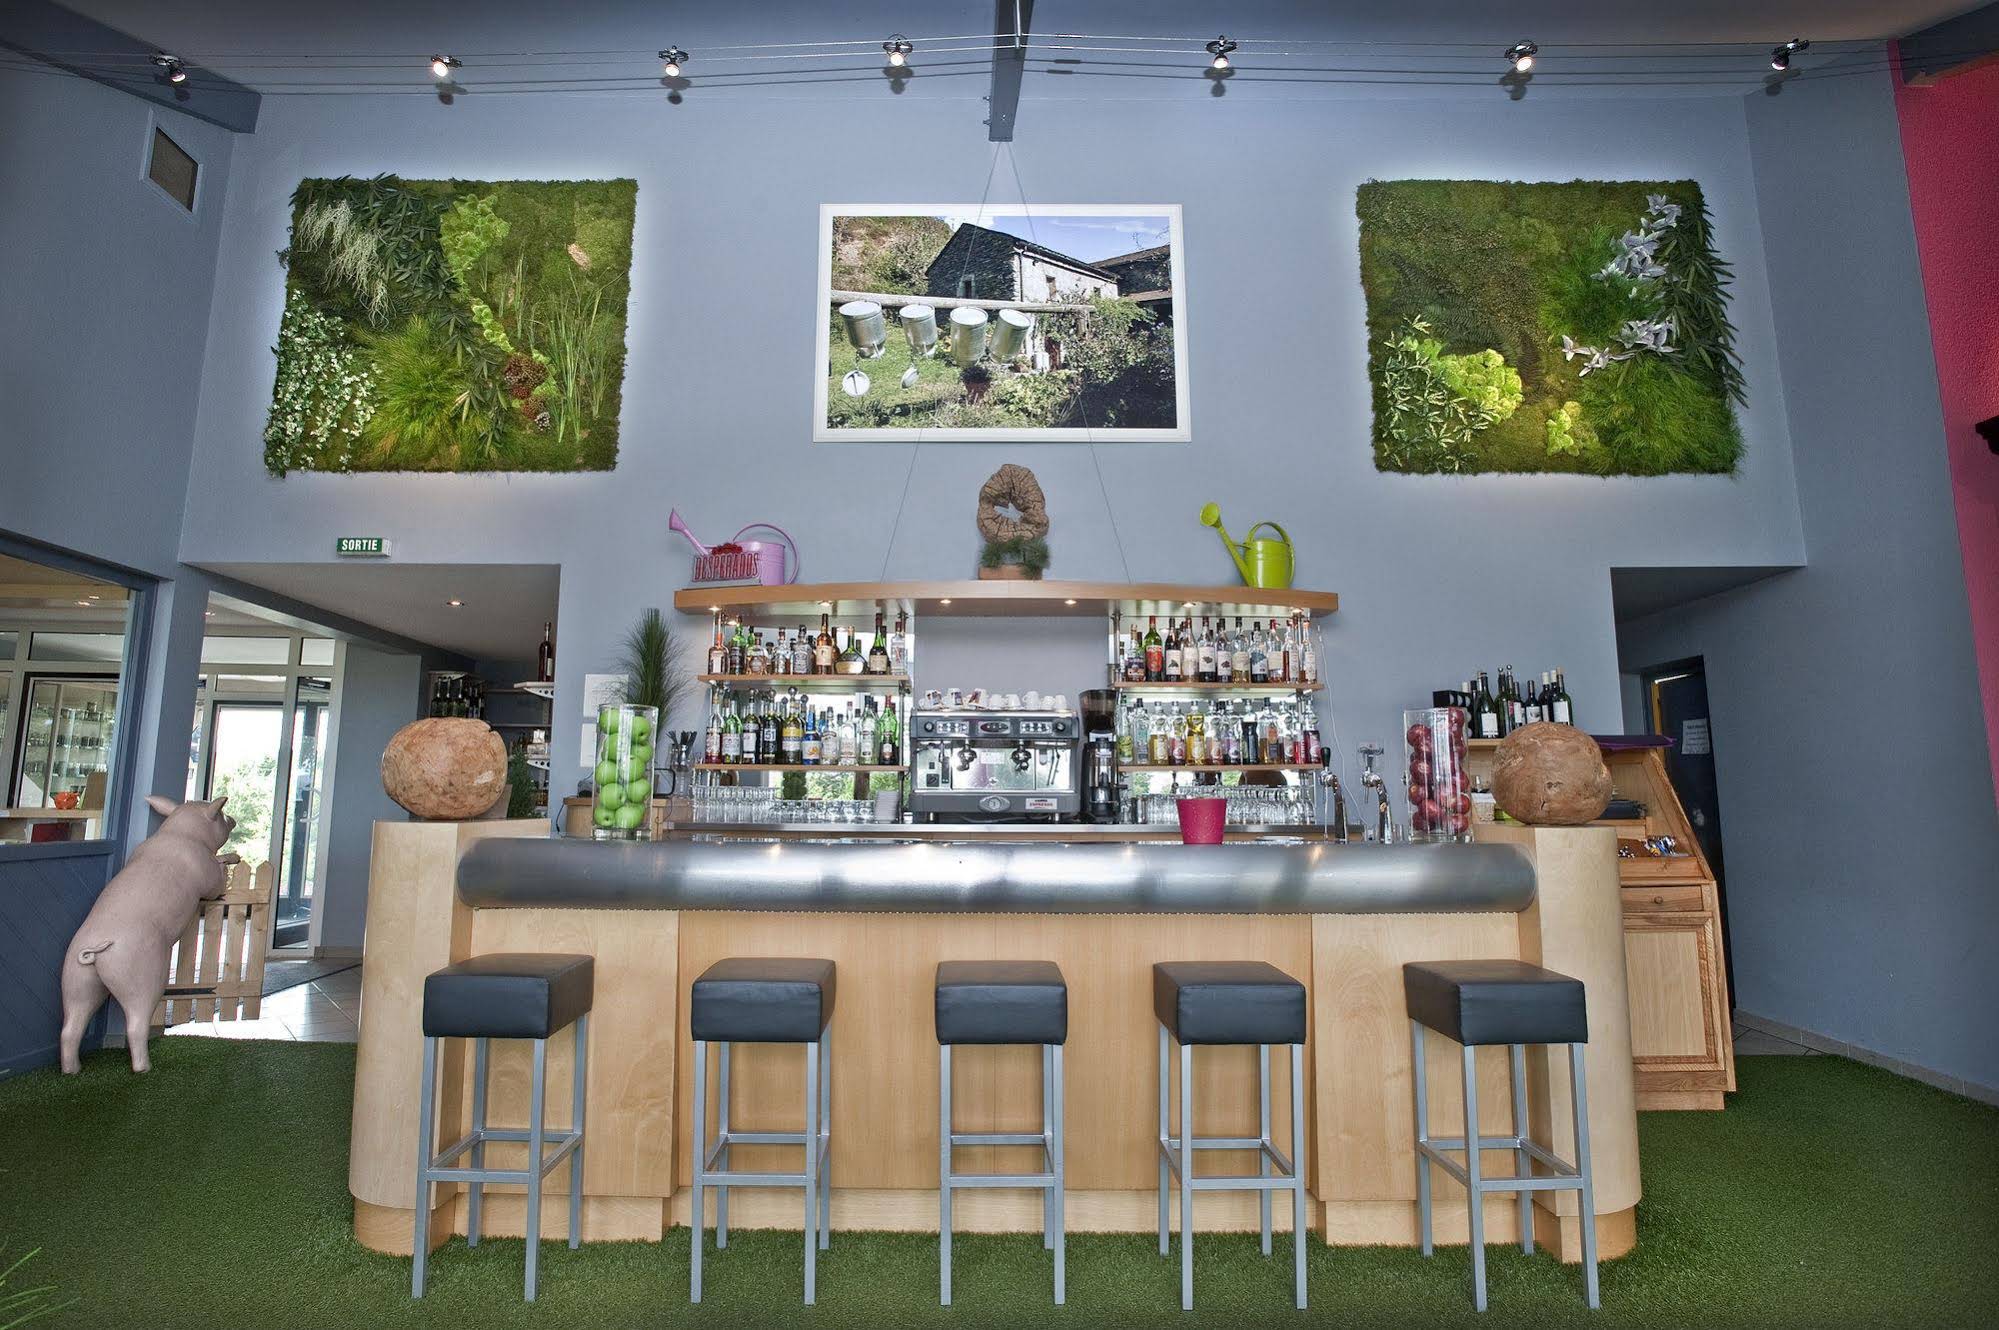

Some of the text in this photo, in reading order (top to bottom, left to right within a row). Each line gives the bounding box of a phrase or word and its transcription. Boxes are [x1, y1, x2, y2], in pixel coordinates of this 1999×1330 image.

[341, 539, 378, 551] SORTIE
[694, 552, 760, 581] DESPERADOS
[765, 730, 775, 740] 51
